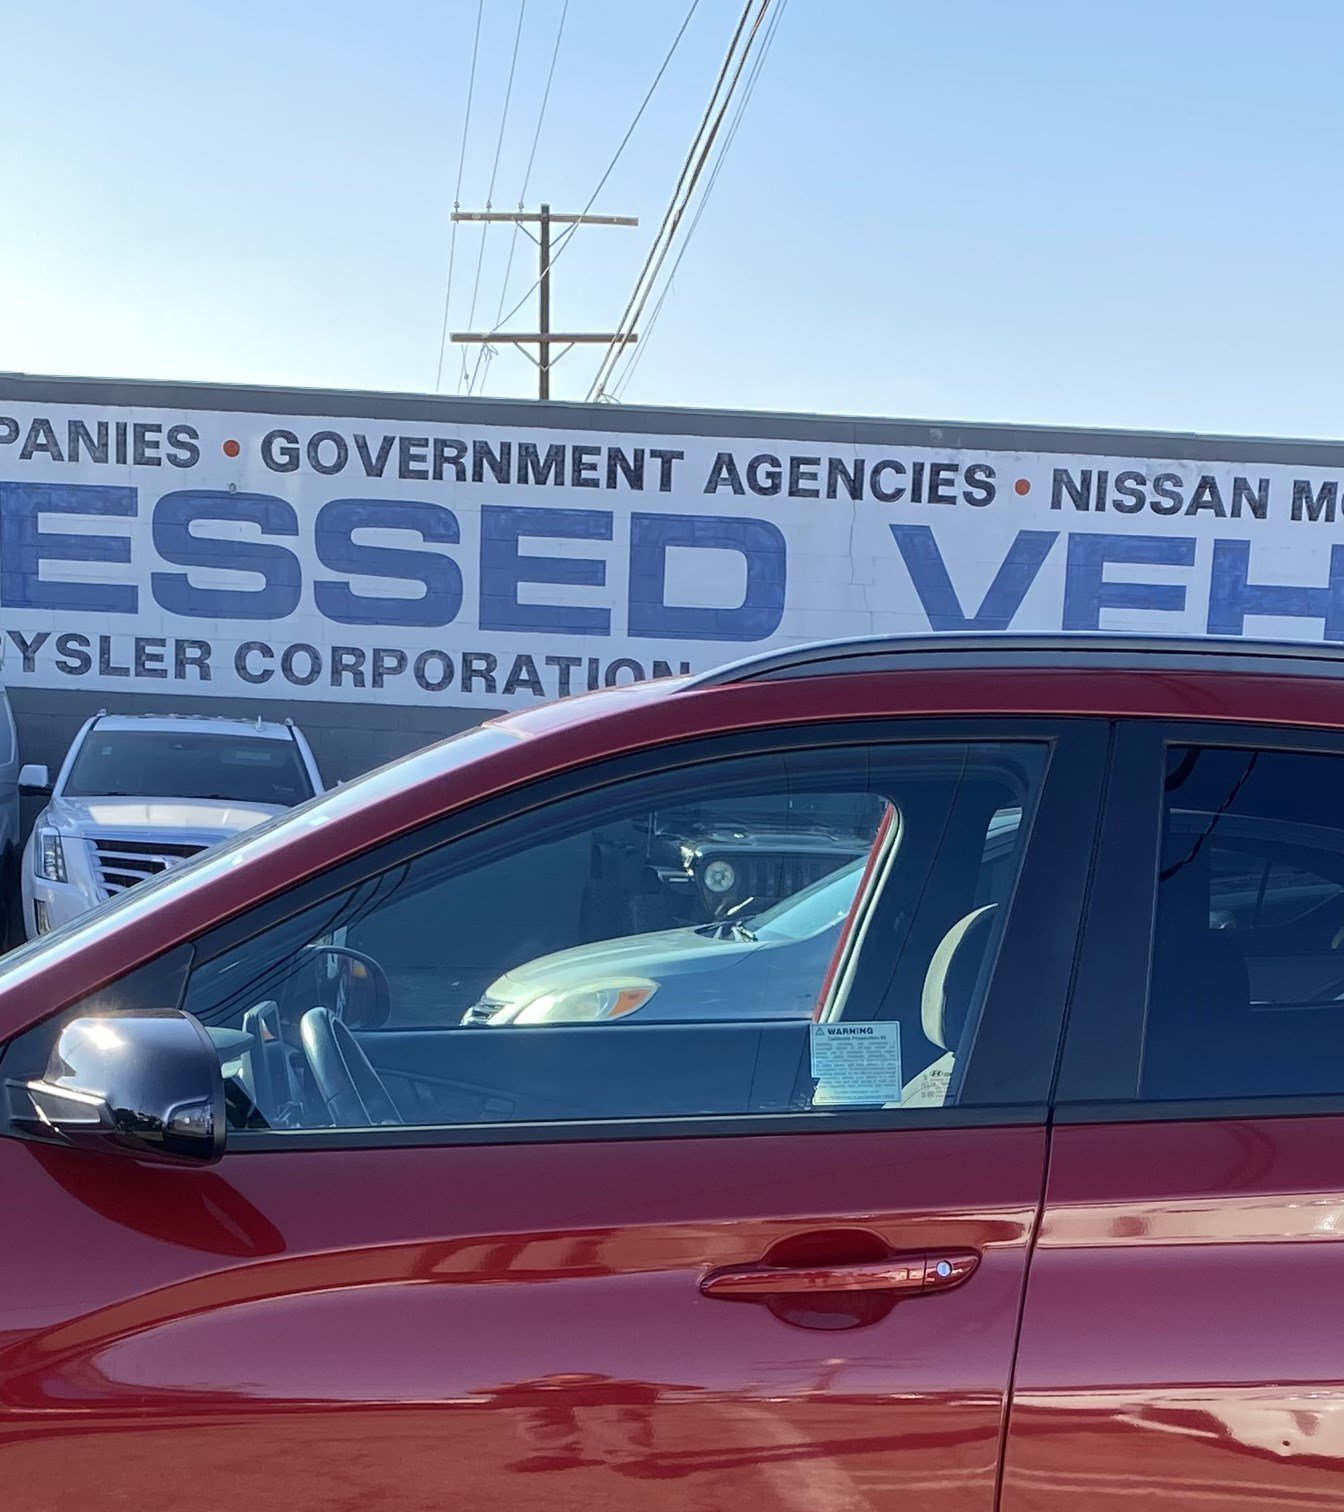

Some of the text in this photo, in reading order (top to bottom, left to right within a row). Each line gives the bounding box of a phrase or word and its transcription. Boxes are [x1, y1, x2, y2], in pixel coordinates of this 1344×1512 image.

[261, 429, 685, 492] GOVERNMENT
[703, 452, 997, 507] AGENCIES
[1049, 467, 1269, 520] NISSAN
[827, 1027, 874, 1035] WARNING
